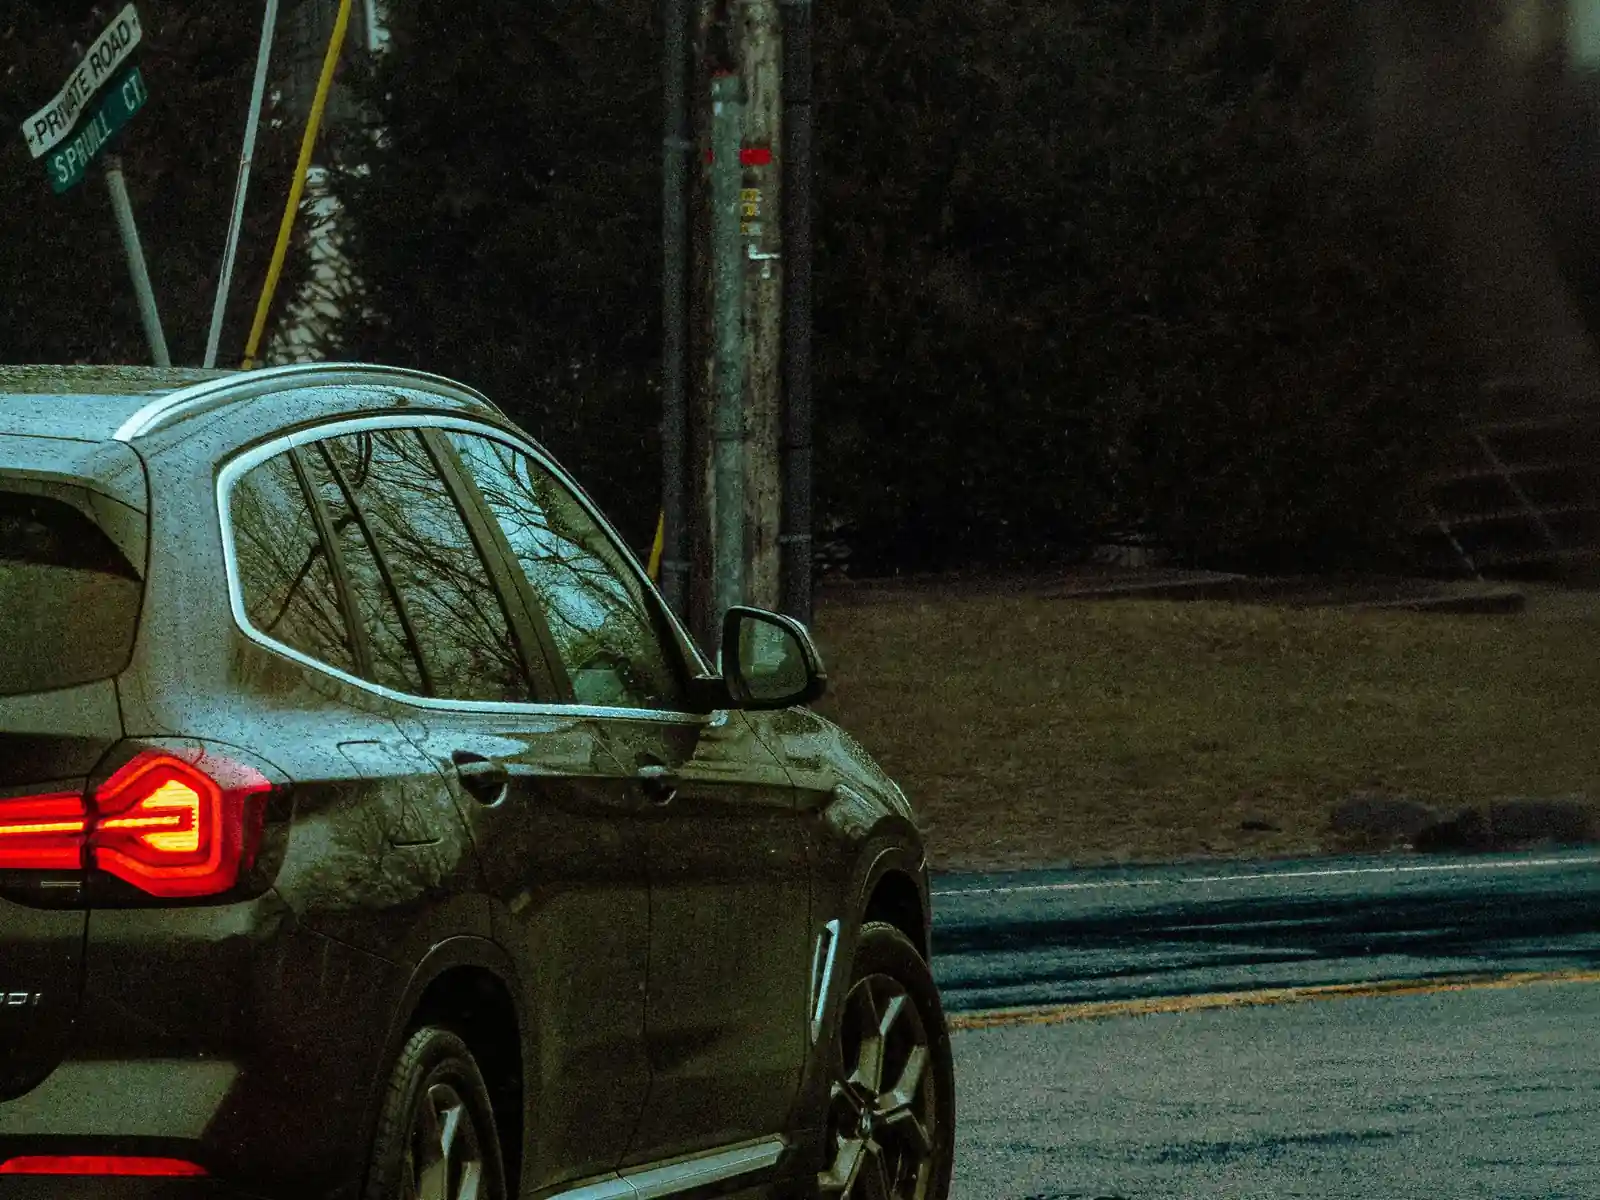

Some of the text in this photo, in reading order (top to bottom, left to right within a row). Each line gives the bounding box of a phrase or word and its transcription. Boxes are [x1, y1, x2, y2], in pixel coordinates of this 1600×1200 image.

[33, 20, 131, 145] PRIVATE ROAD
[122, 75, 143, 111] CT
